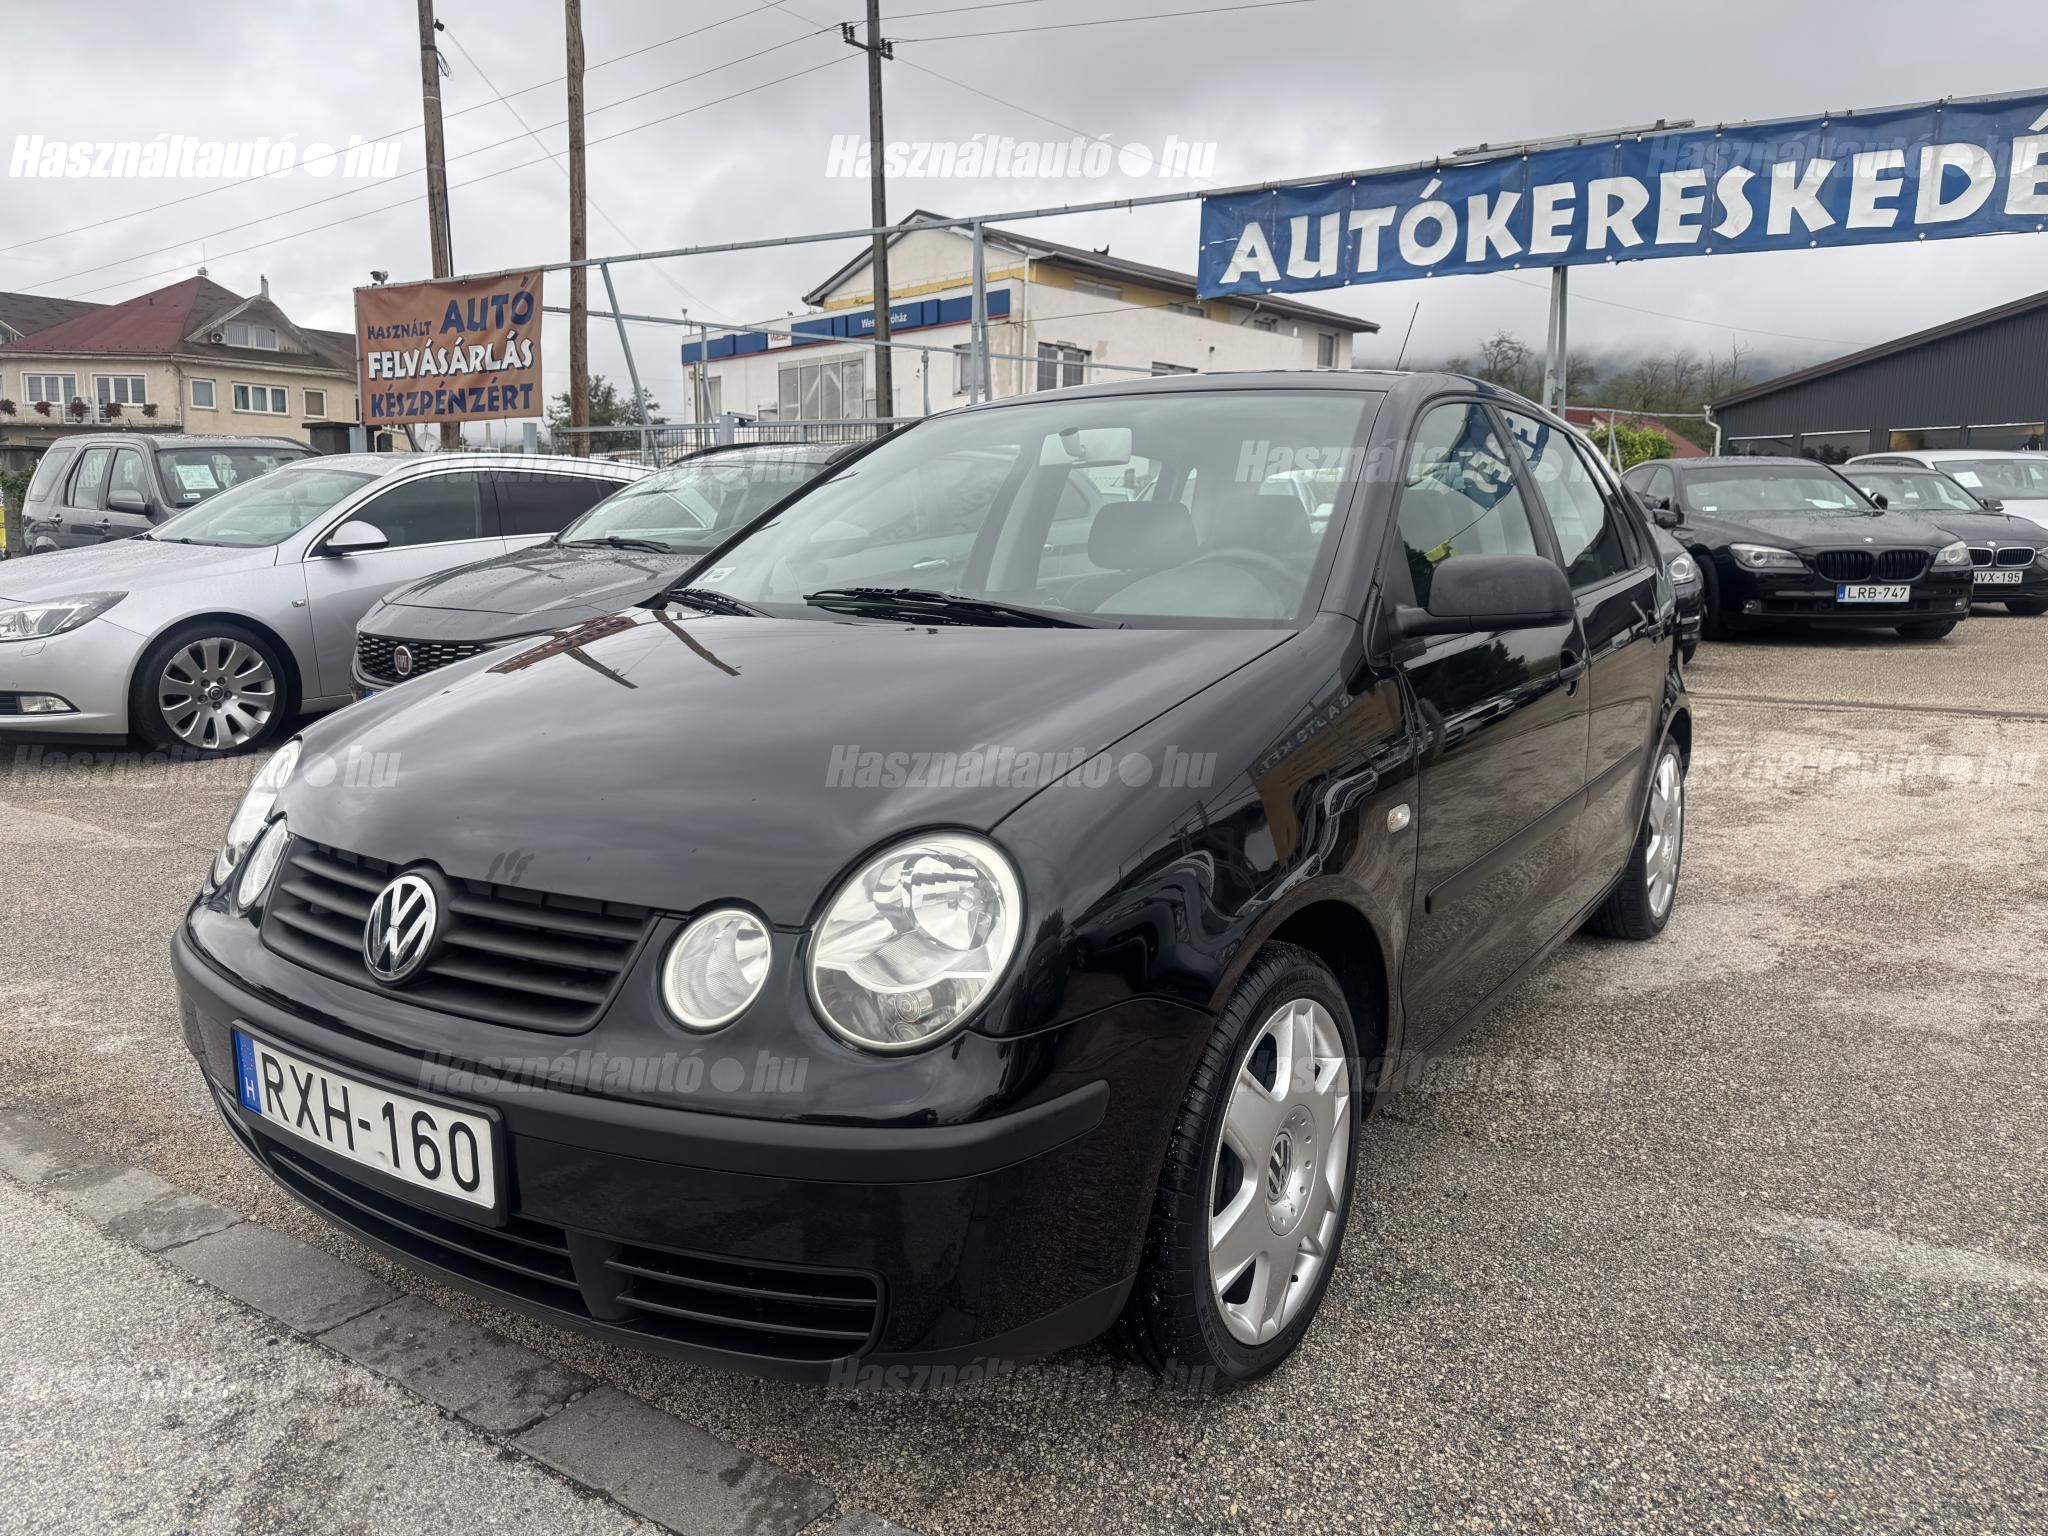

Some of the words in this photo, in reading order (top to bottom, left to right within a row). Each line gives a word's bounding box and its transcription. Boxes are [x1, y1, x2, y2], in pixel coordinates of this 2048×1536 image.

[367, 317, 432, 340] HASZNÁLT
[440, 276, 534, 334] AUTÓ
[367, 329, 533, 381] FELVÁSÁRLÁS
[371, 376, 534, 418] KÉSZPÉNZÉRT
[1848, 586, 1907, 599] LRB-747
[244, 1078, 256, 1101] H
[261, 1051, 481, 1193] RXH-160
